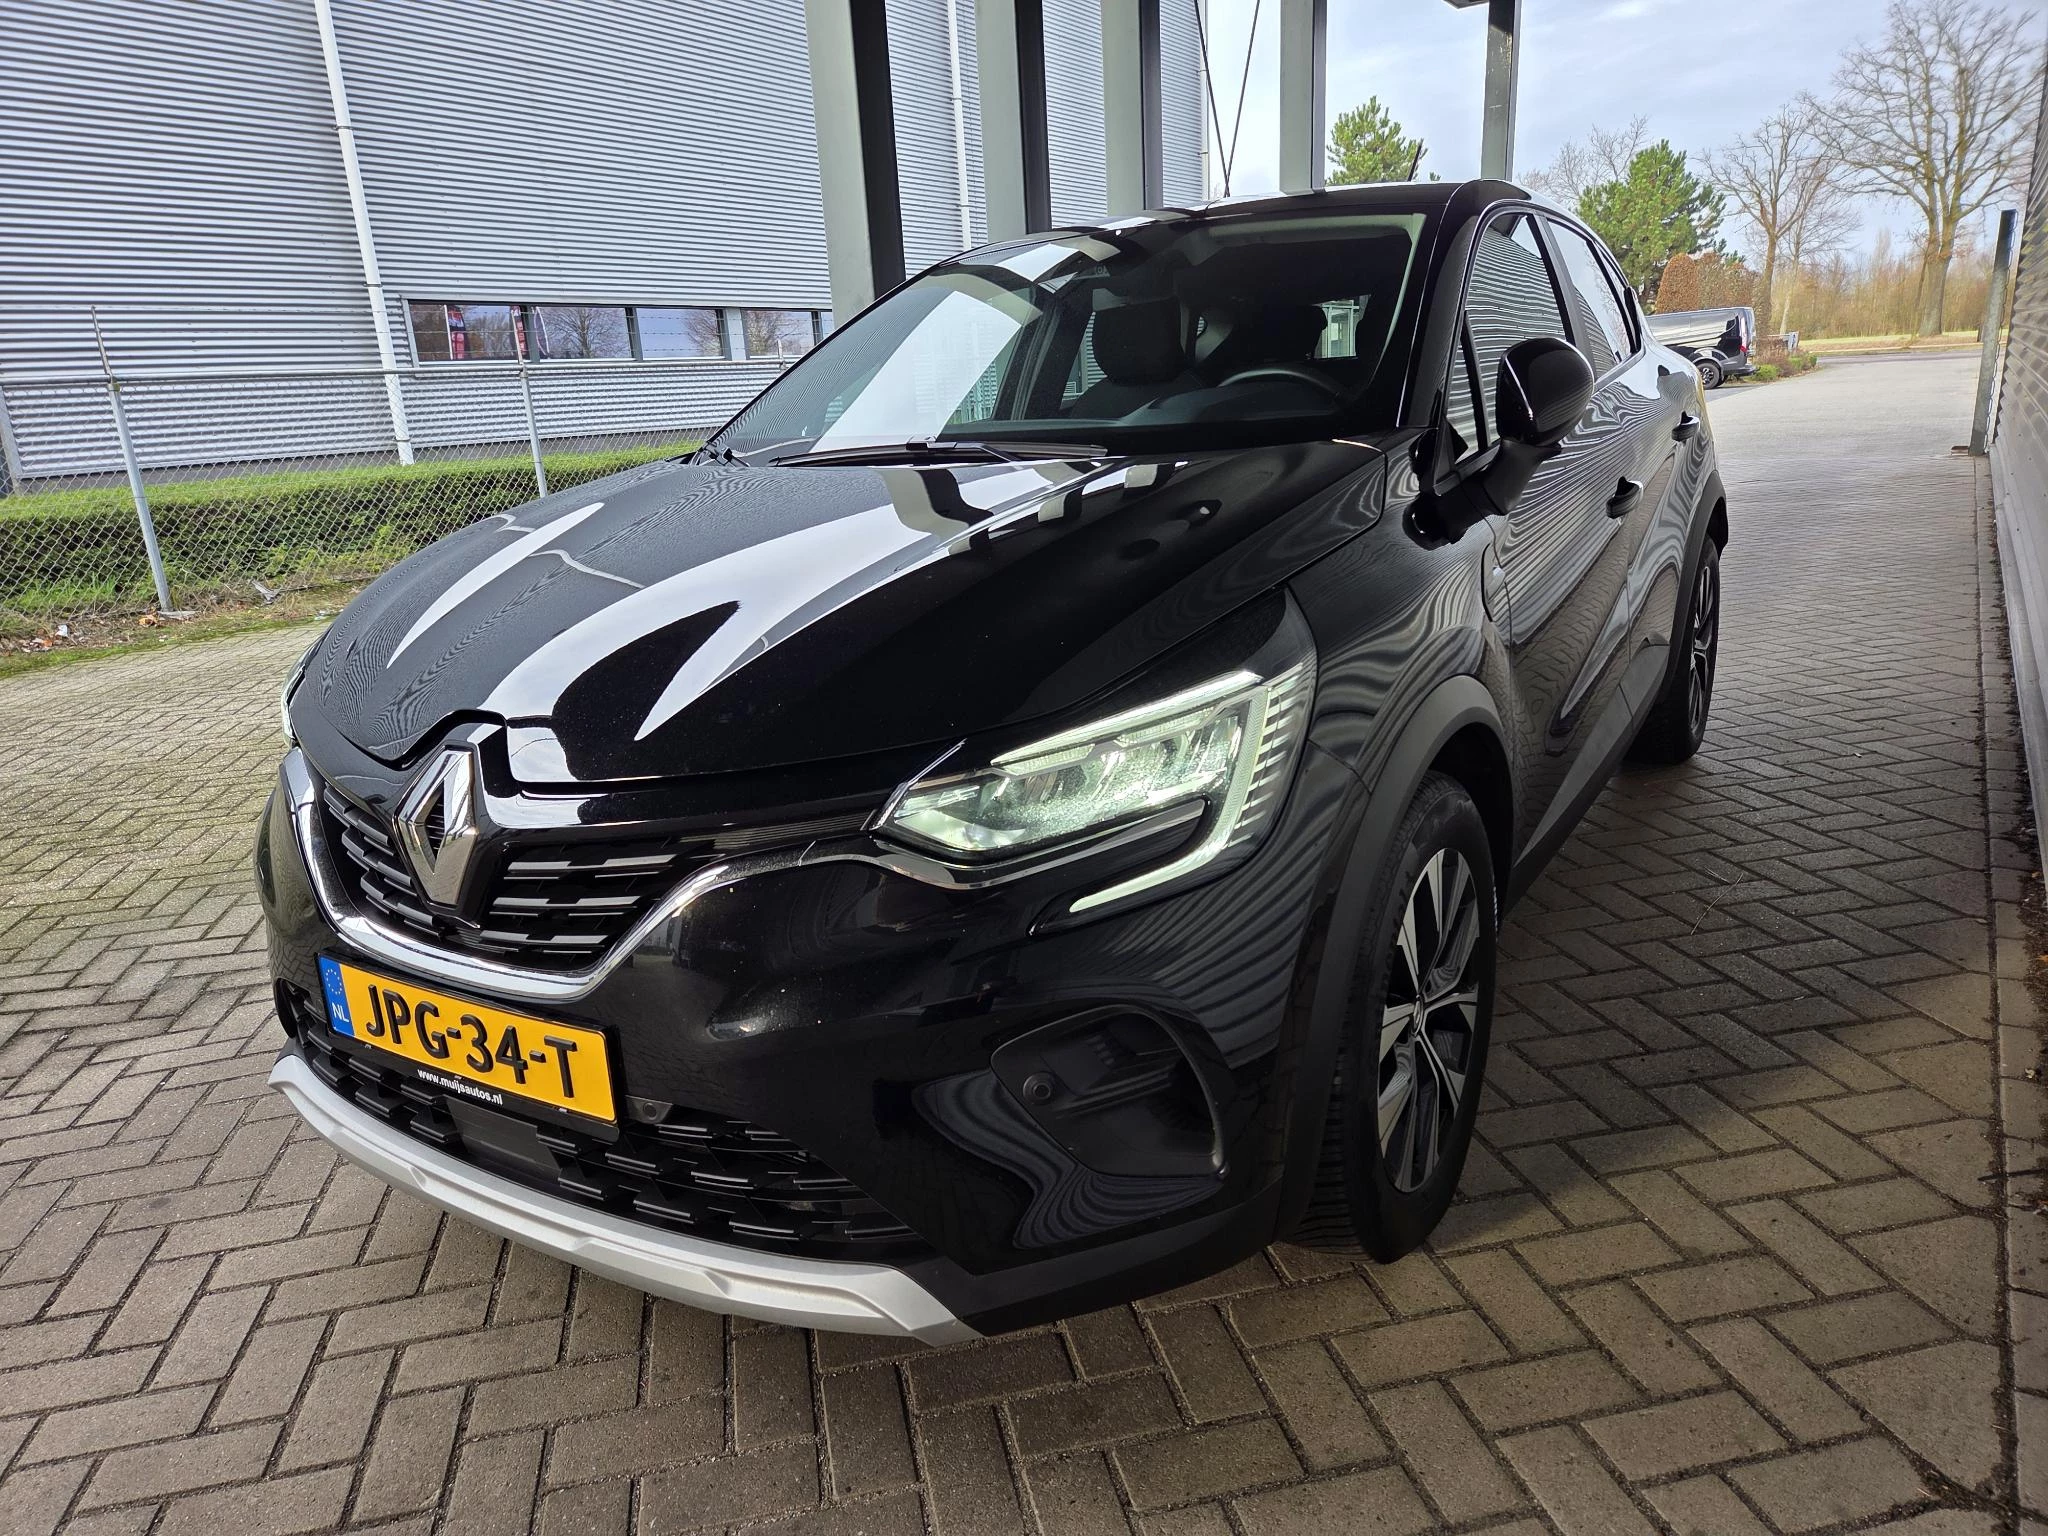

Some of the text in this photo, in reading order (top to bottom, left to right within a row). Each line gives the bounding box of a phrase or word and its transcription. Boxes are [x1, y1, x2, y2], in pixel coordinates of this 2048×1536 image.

[332, 1002, 350, 1022] NL
[366, 984, 577, 1099] JPG-34-T
[417, 1069, 503, 1105] www.muijsautos.nl
